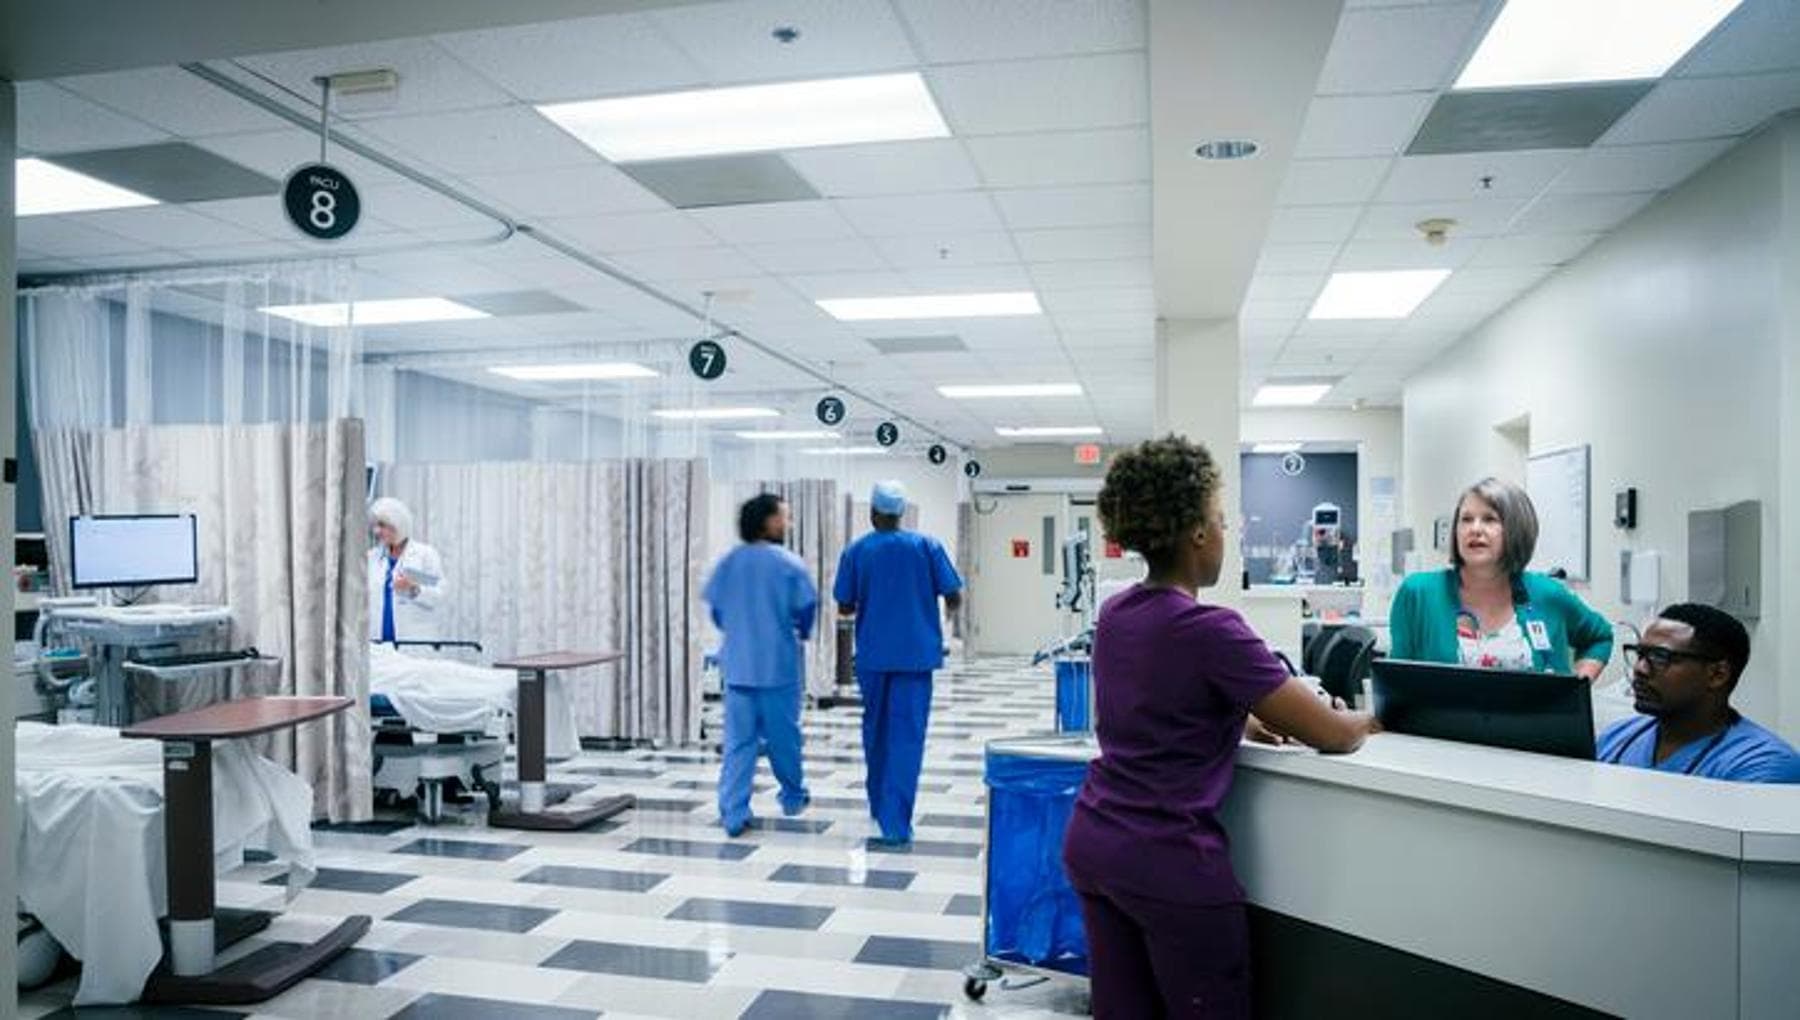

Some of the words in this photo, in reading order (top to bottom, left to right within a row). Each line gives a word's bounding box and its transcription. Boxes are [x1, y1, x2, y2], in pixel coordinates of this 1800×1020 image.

[310, 191, 335, 228] 8
[701, 353, 714, 375] 7
[825, 406, 837, 420] 6
[882, 430, 892, 443] 5
